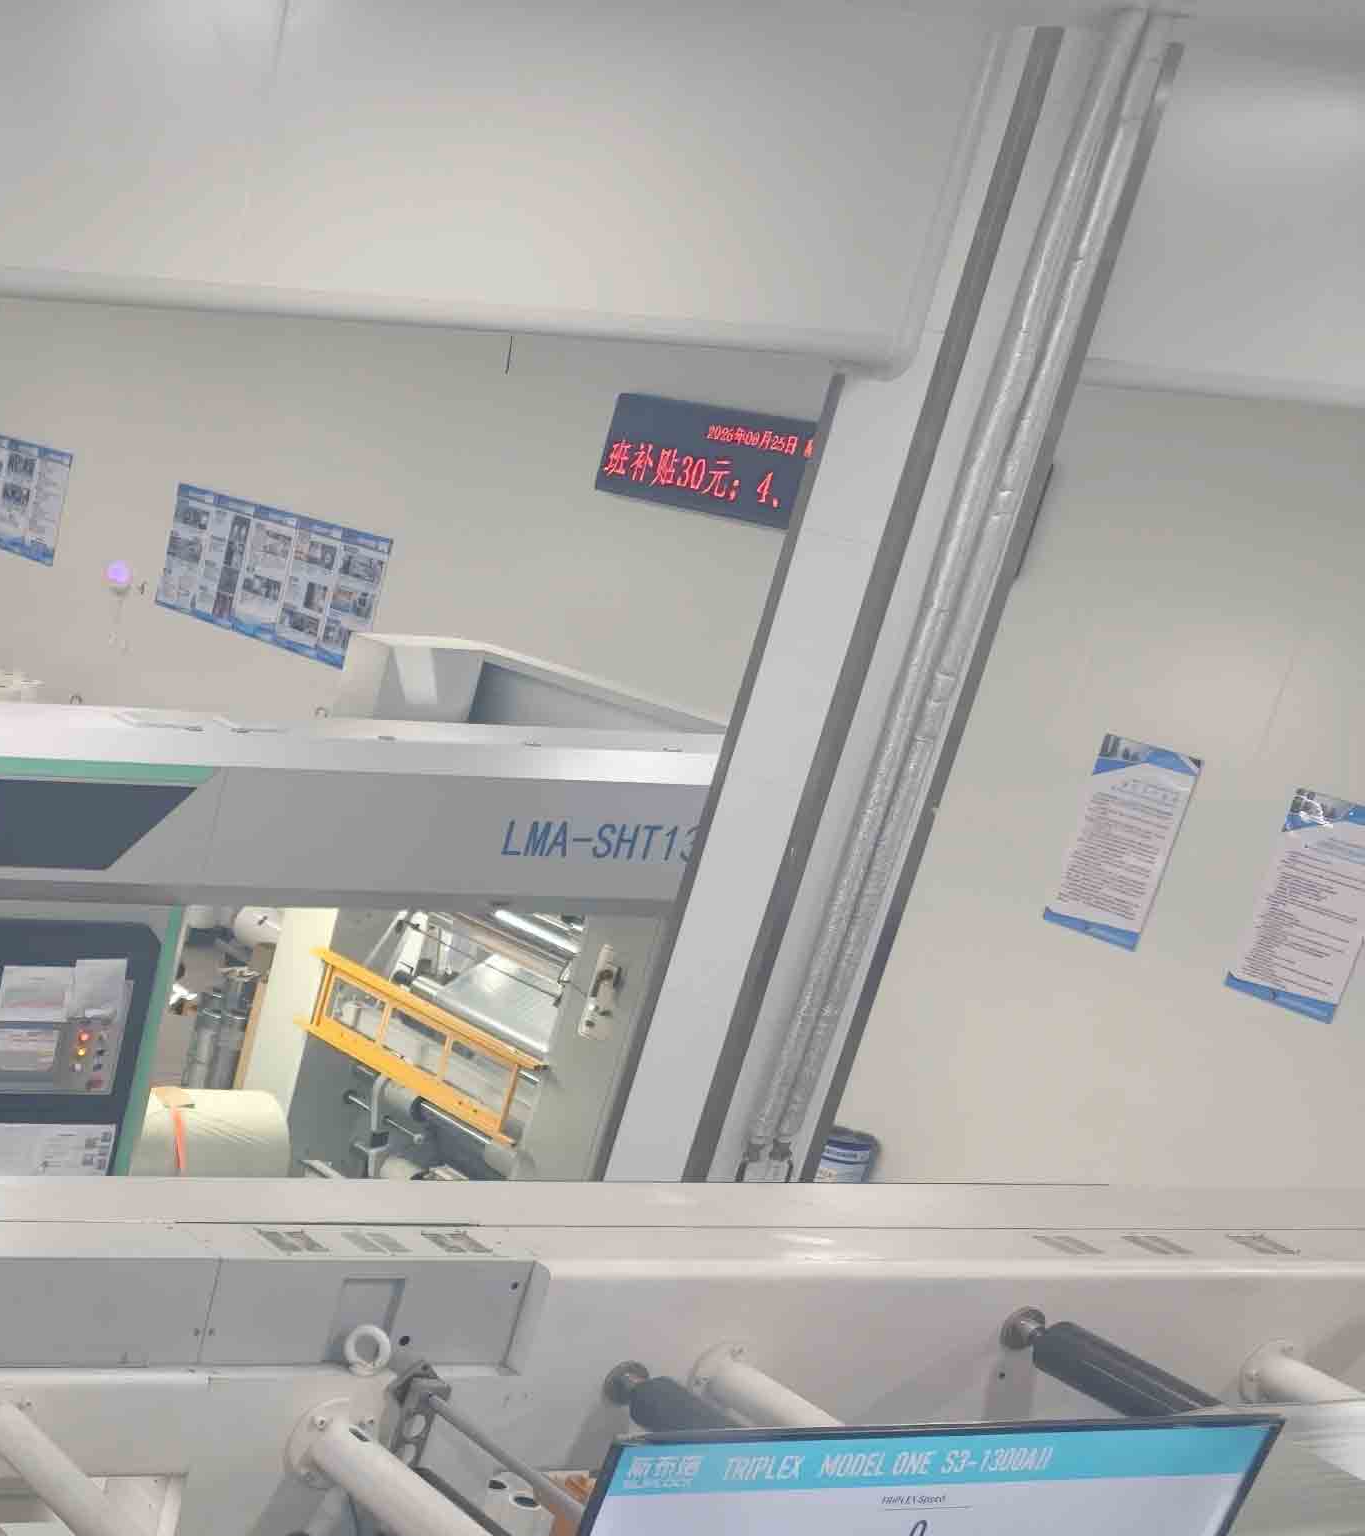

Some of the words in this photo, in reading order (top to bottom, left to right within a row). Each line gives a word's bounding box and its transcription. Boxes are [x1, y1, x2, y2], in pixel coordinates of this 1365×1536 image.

[723, 1455, 805, 1481] TRIPLEX
[820, 1452, 886, 1477] MODEL
[892, 1450, 933, 1475] ONE
